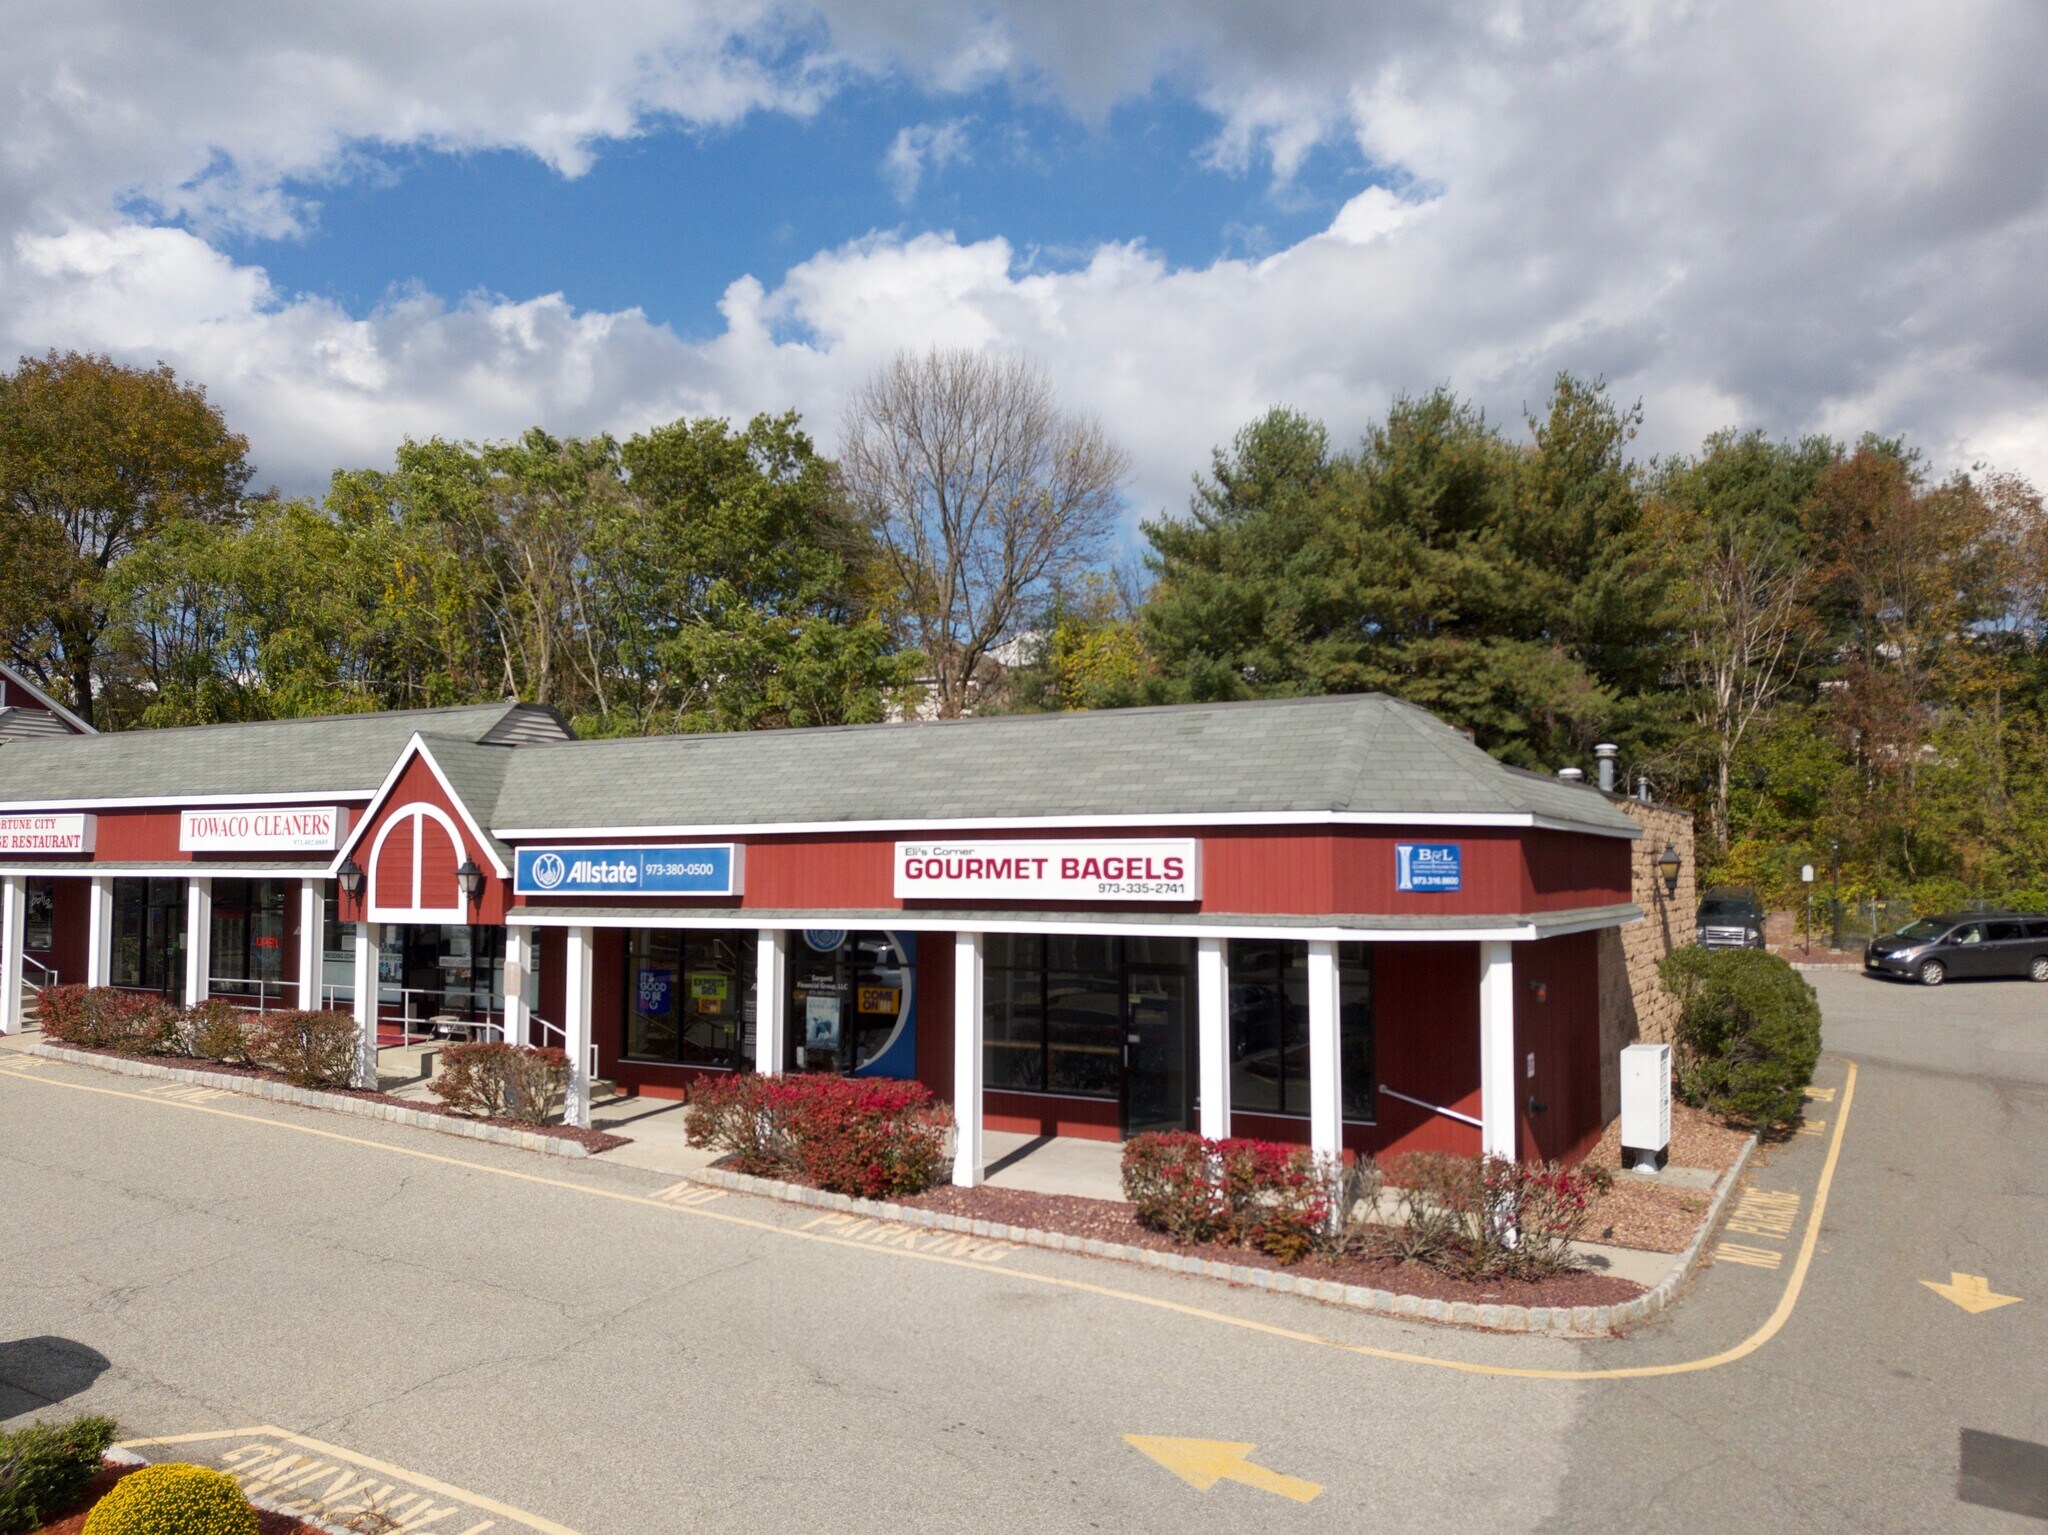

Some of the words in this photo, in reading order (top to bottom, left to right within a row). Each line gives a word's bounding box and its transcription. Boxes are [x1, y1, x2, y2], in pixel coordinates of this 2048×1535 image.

[0, 819, 31, 830] RTUNE
[34, 818, 56, 829] CITY
[190, 816, 249, 838] TOWACO
[254, 814, 330, 837] CLEANERS
[11, 834, 81, 848] RESTAURANT
[904, 847, 928, 856] Eli's
[932, 847, 975, 856] Corner
[1418, 848, 1454, 863] B&L
[566, 860, 638, 884] Allstate
[645, 863, 714, 876] 973-380-0500
[904, 858, 1049, 880] GOURMET
[1060, 856, 1185, 881] BAGELS
[1098, 882, 1185, 894] 973-335-2741
[640, 982, 668, 992] GOOD
[640, 991, 651, 1001] TO
[652, 991, 662, 1001] BE
[862, 990, 894, 1000] COME
[862, 1000, 878, 1010] ON
[1725, 1186, 1801, 1240] PARKING
[649, 1181, 728, 1205] NO
[799, 1212, 1023, 1263] PARKING
